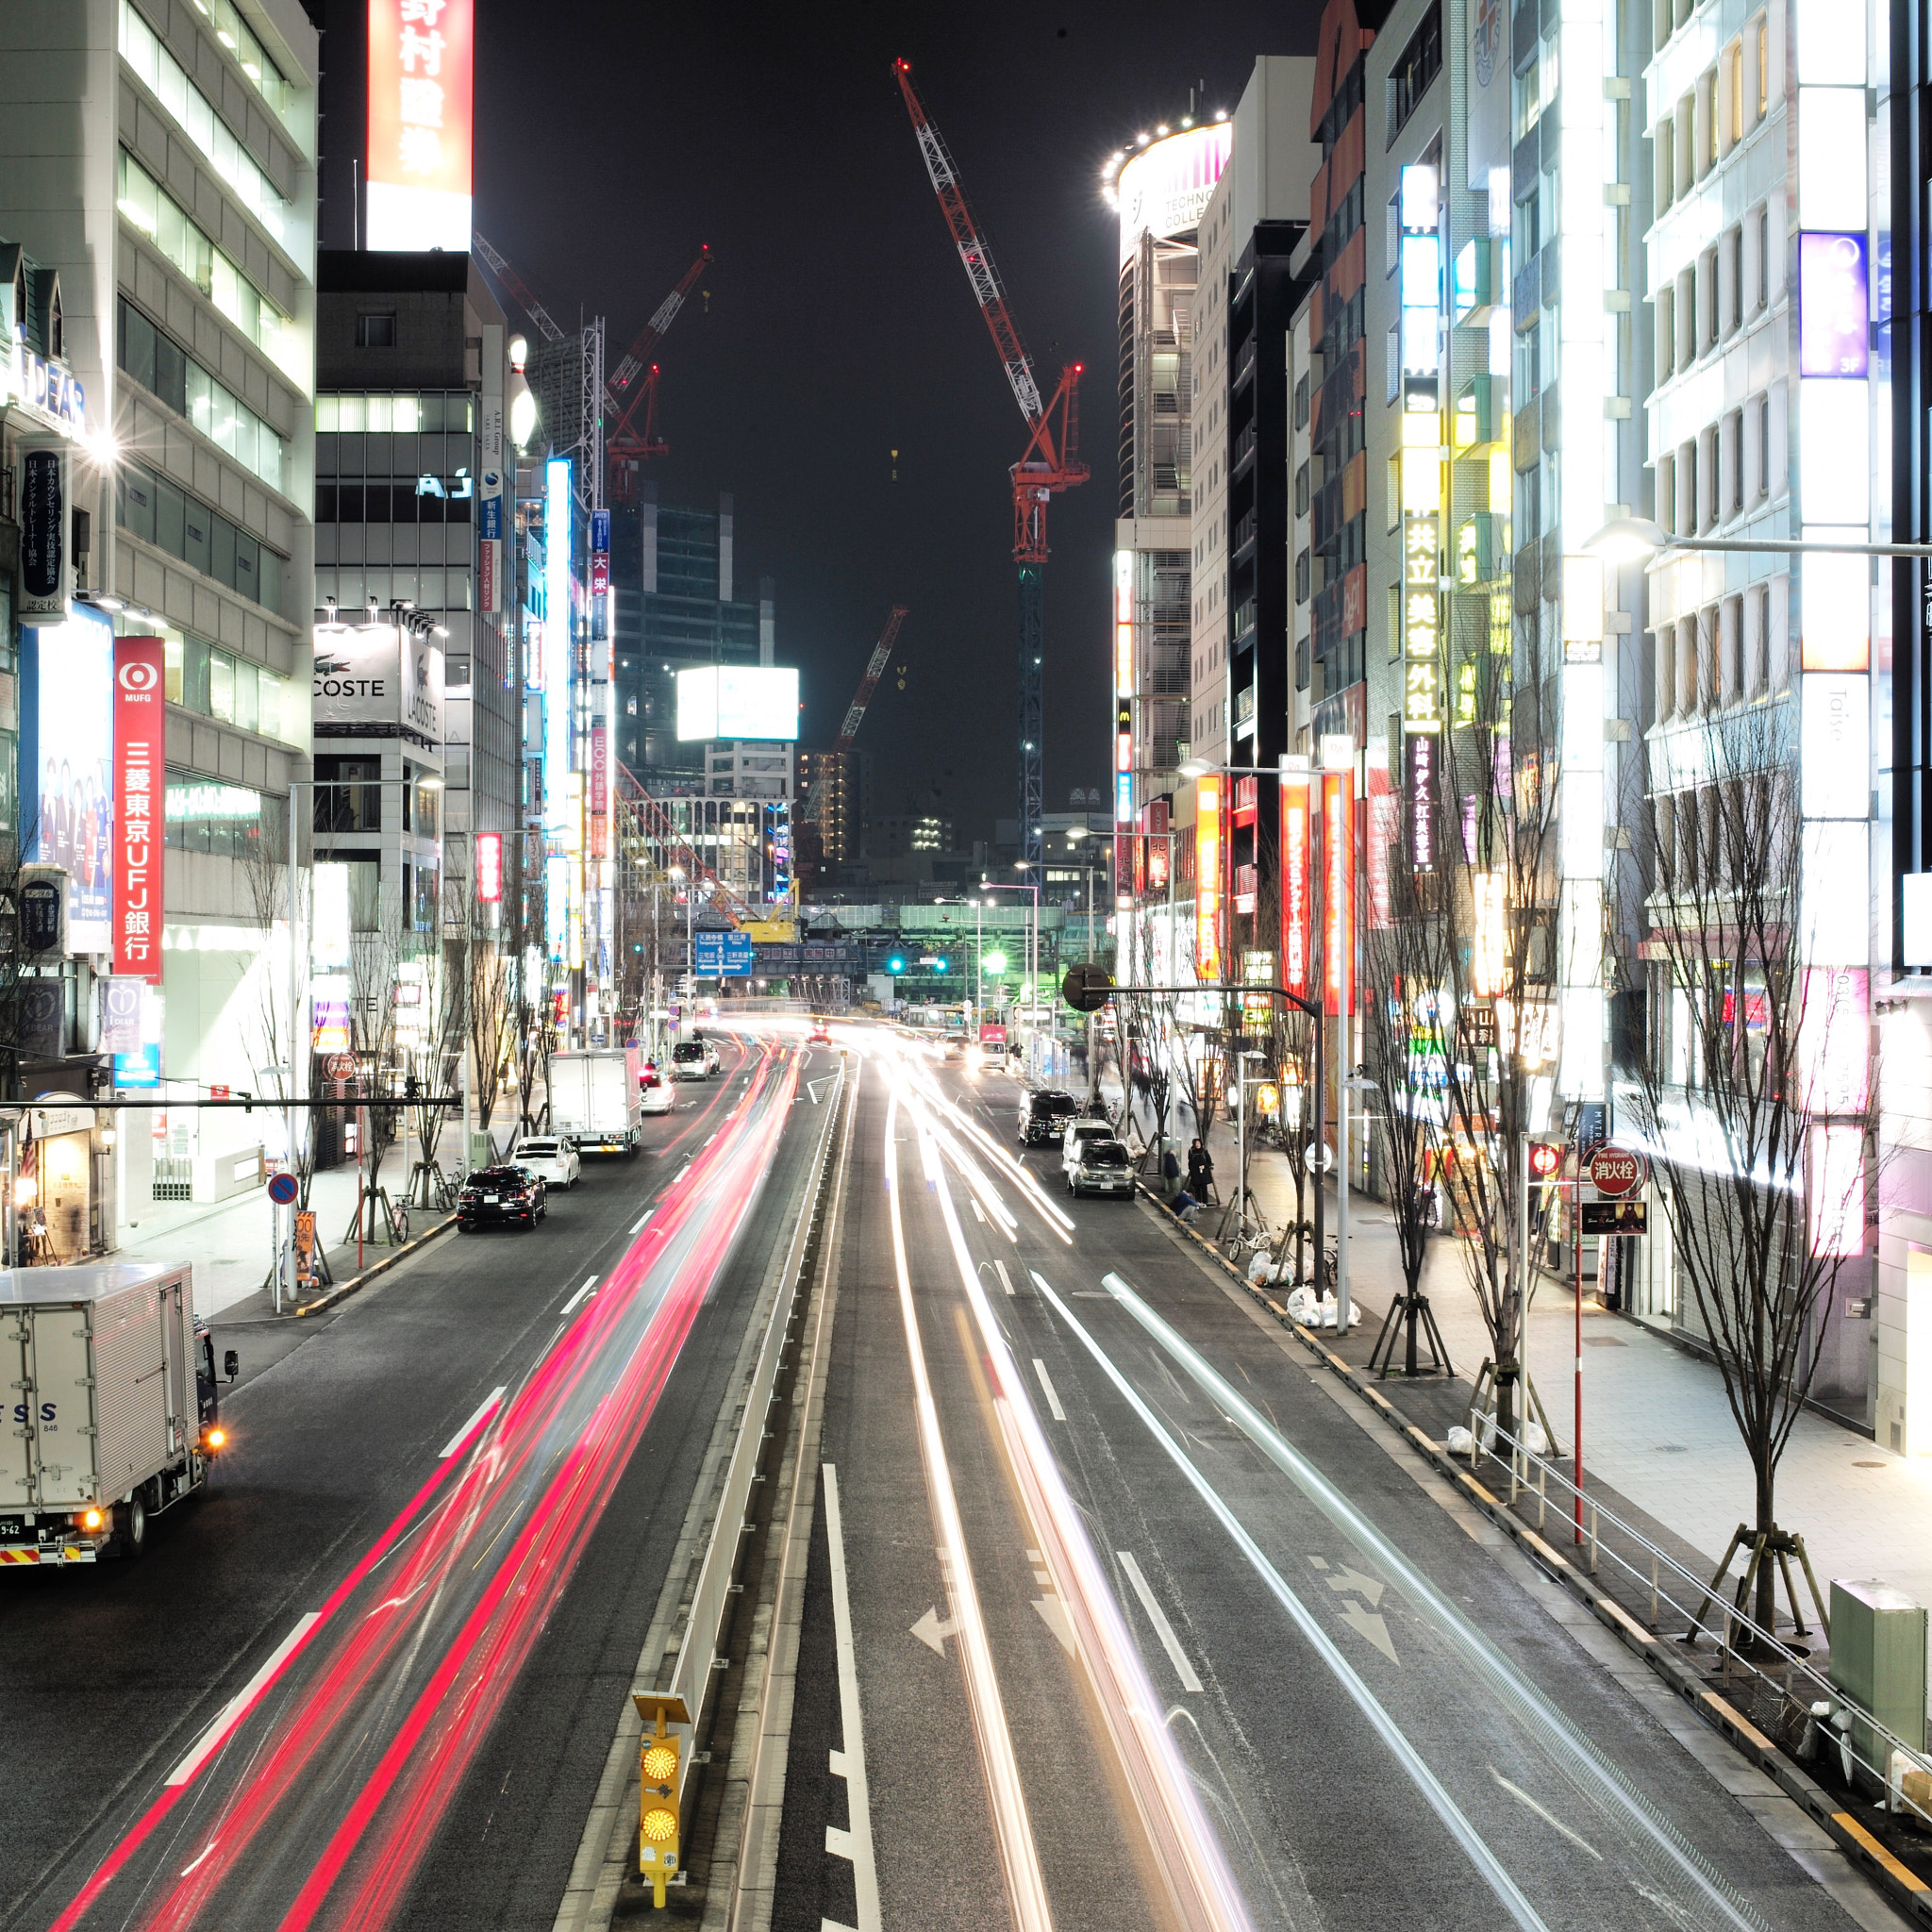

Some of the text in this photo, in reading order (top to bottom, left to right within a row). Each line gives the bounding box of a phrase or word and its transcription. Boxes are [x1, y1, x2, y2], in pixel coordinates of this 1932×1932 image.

[492, 432, 501, 455] Group
[487, 500, 496, 539] 新生銀行
[594, 557, 607, 590] 大栄
[26, 600, 58, 611] 認定校
[125, 693, 151, 702] MUFG
[408, 692, 436, 732] LACOSTE
[125, 741, 151, 960] 三菱東京UFJ銀行
[1594, 1161, 1634, 1180] 消火栓
